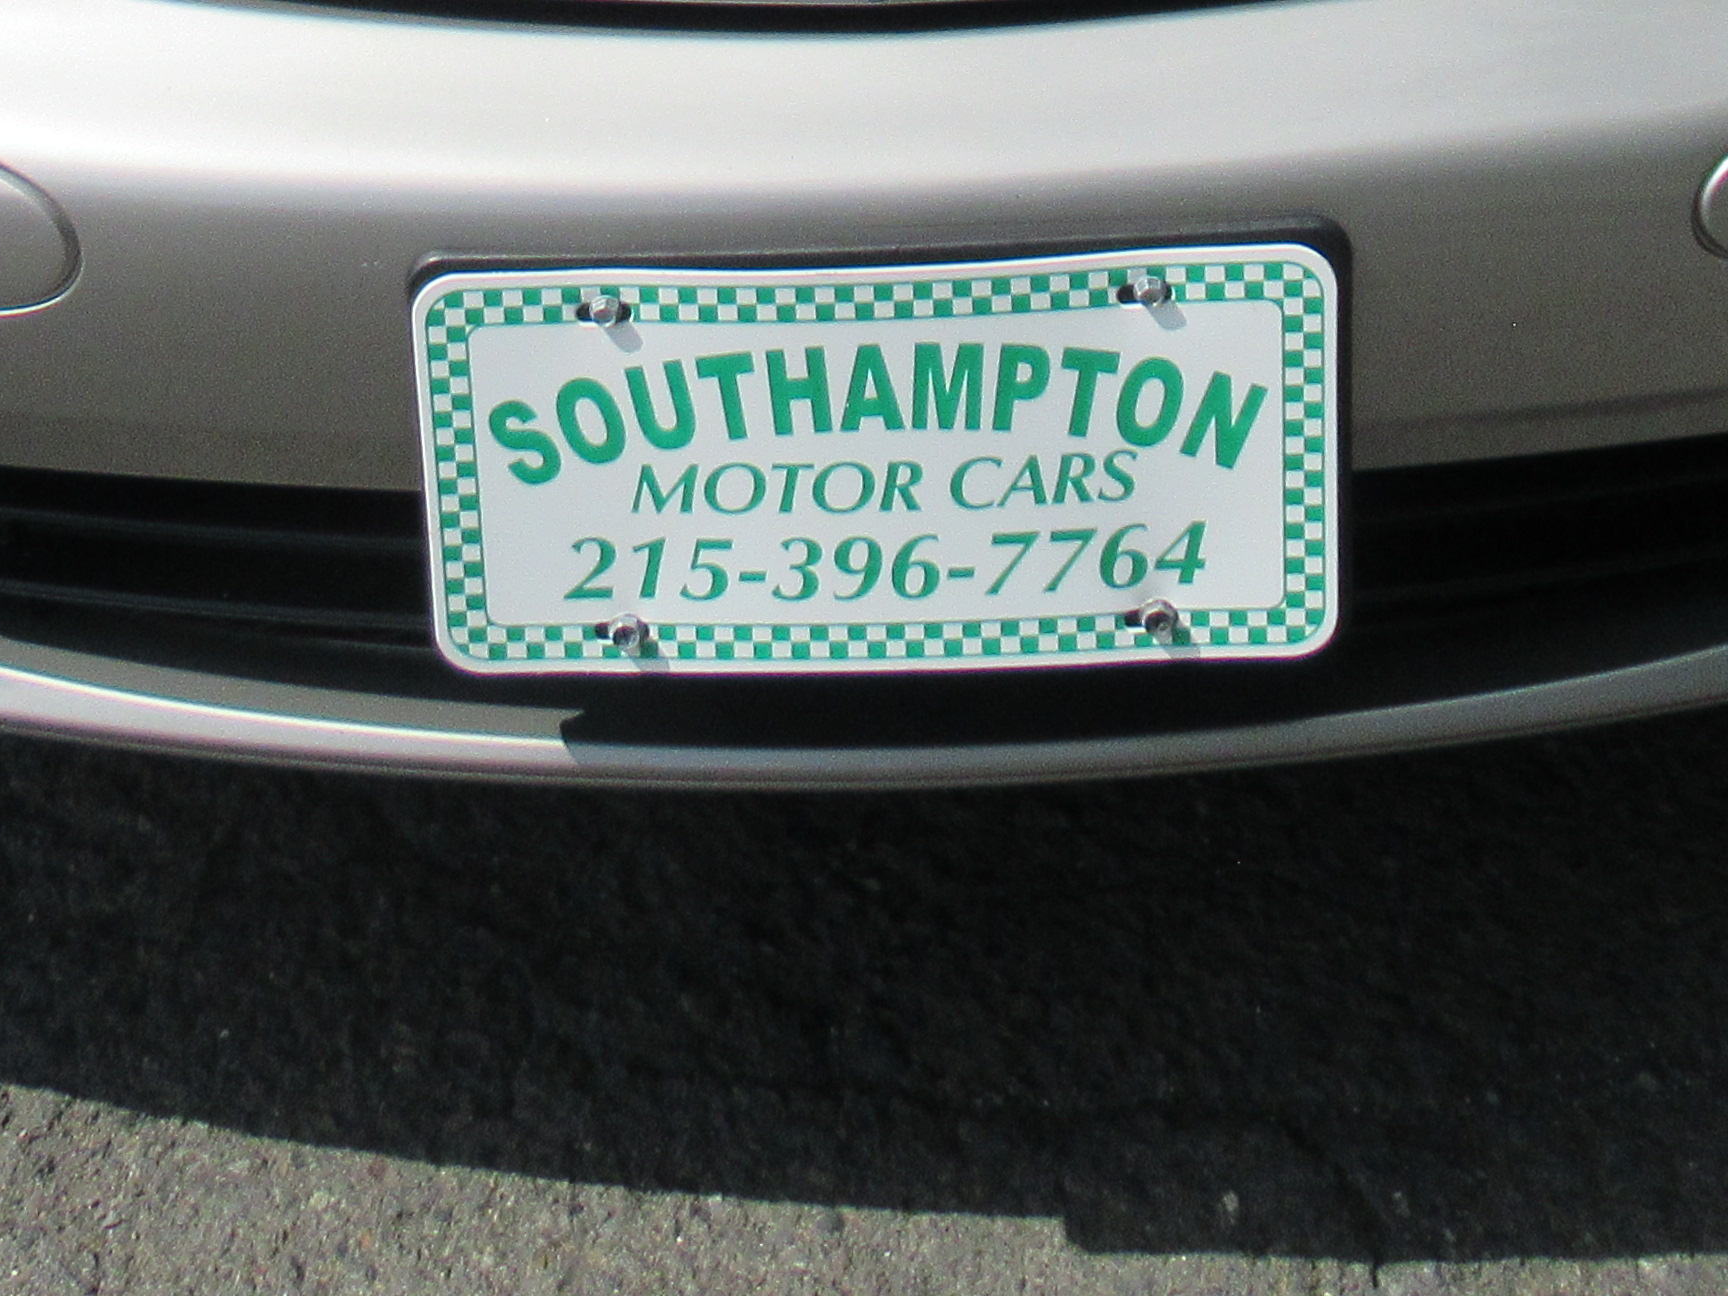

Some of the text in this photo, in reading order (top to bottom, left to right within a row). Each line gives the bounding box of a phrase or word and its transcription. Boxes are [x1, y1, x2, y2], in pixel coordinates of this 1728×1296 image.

[487, 342, 1269, 488] SOUTHAMPTON
[631, 450, 1140, 516] MOTOR CARS
[563, 521, 1208, 604] 215-396-7764
